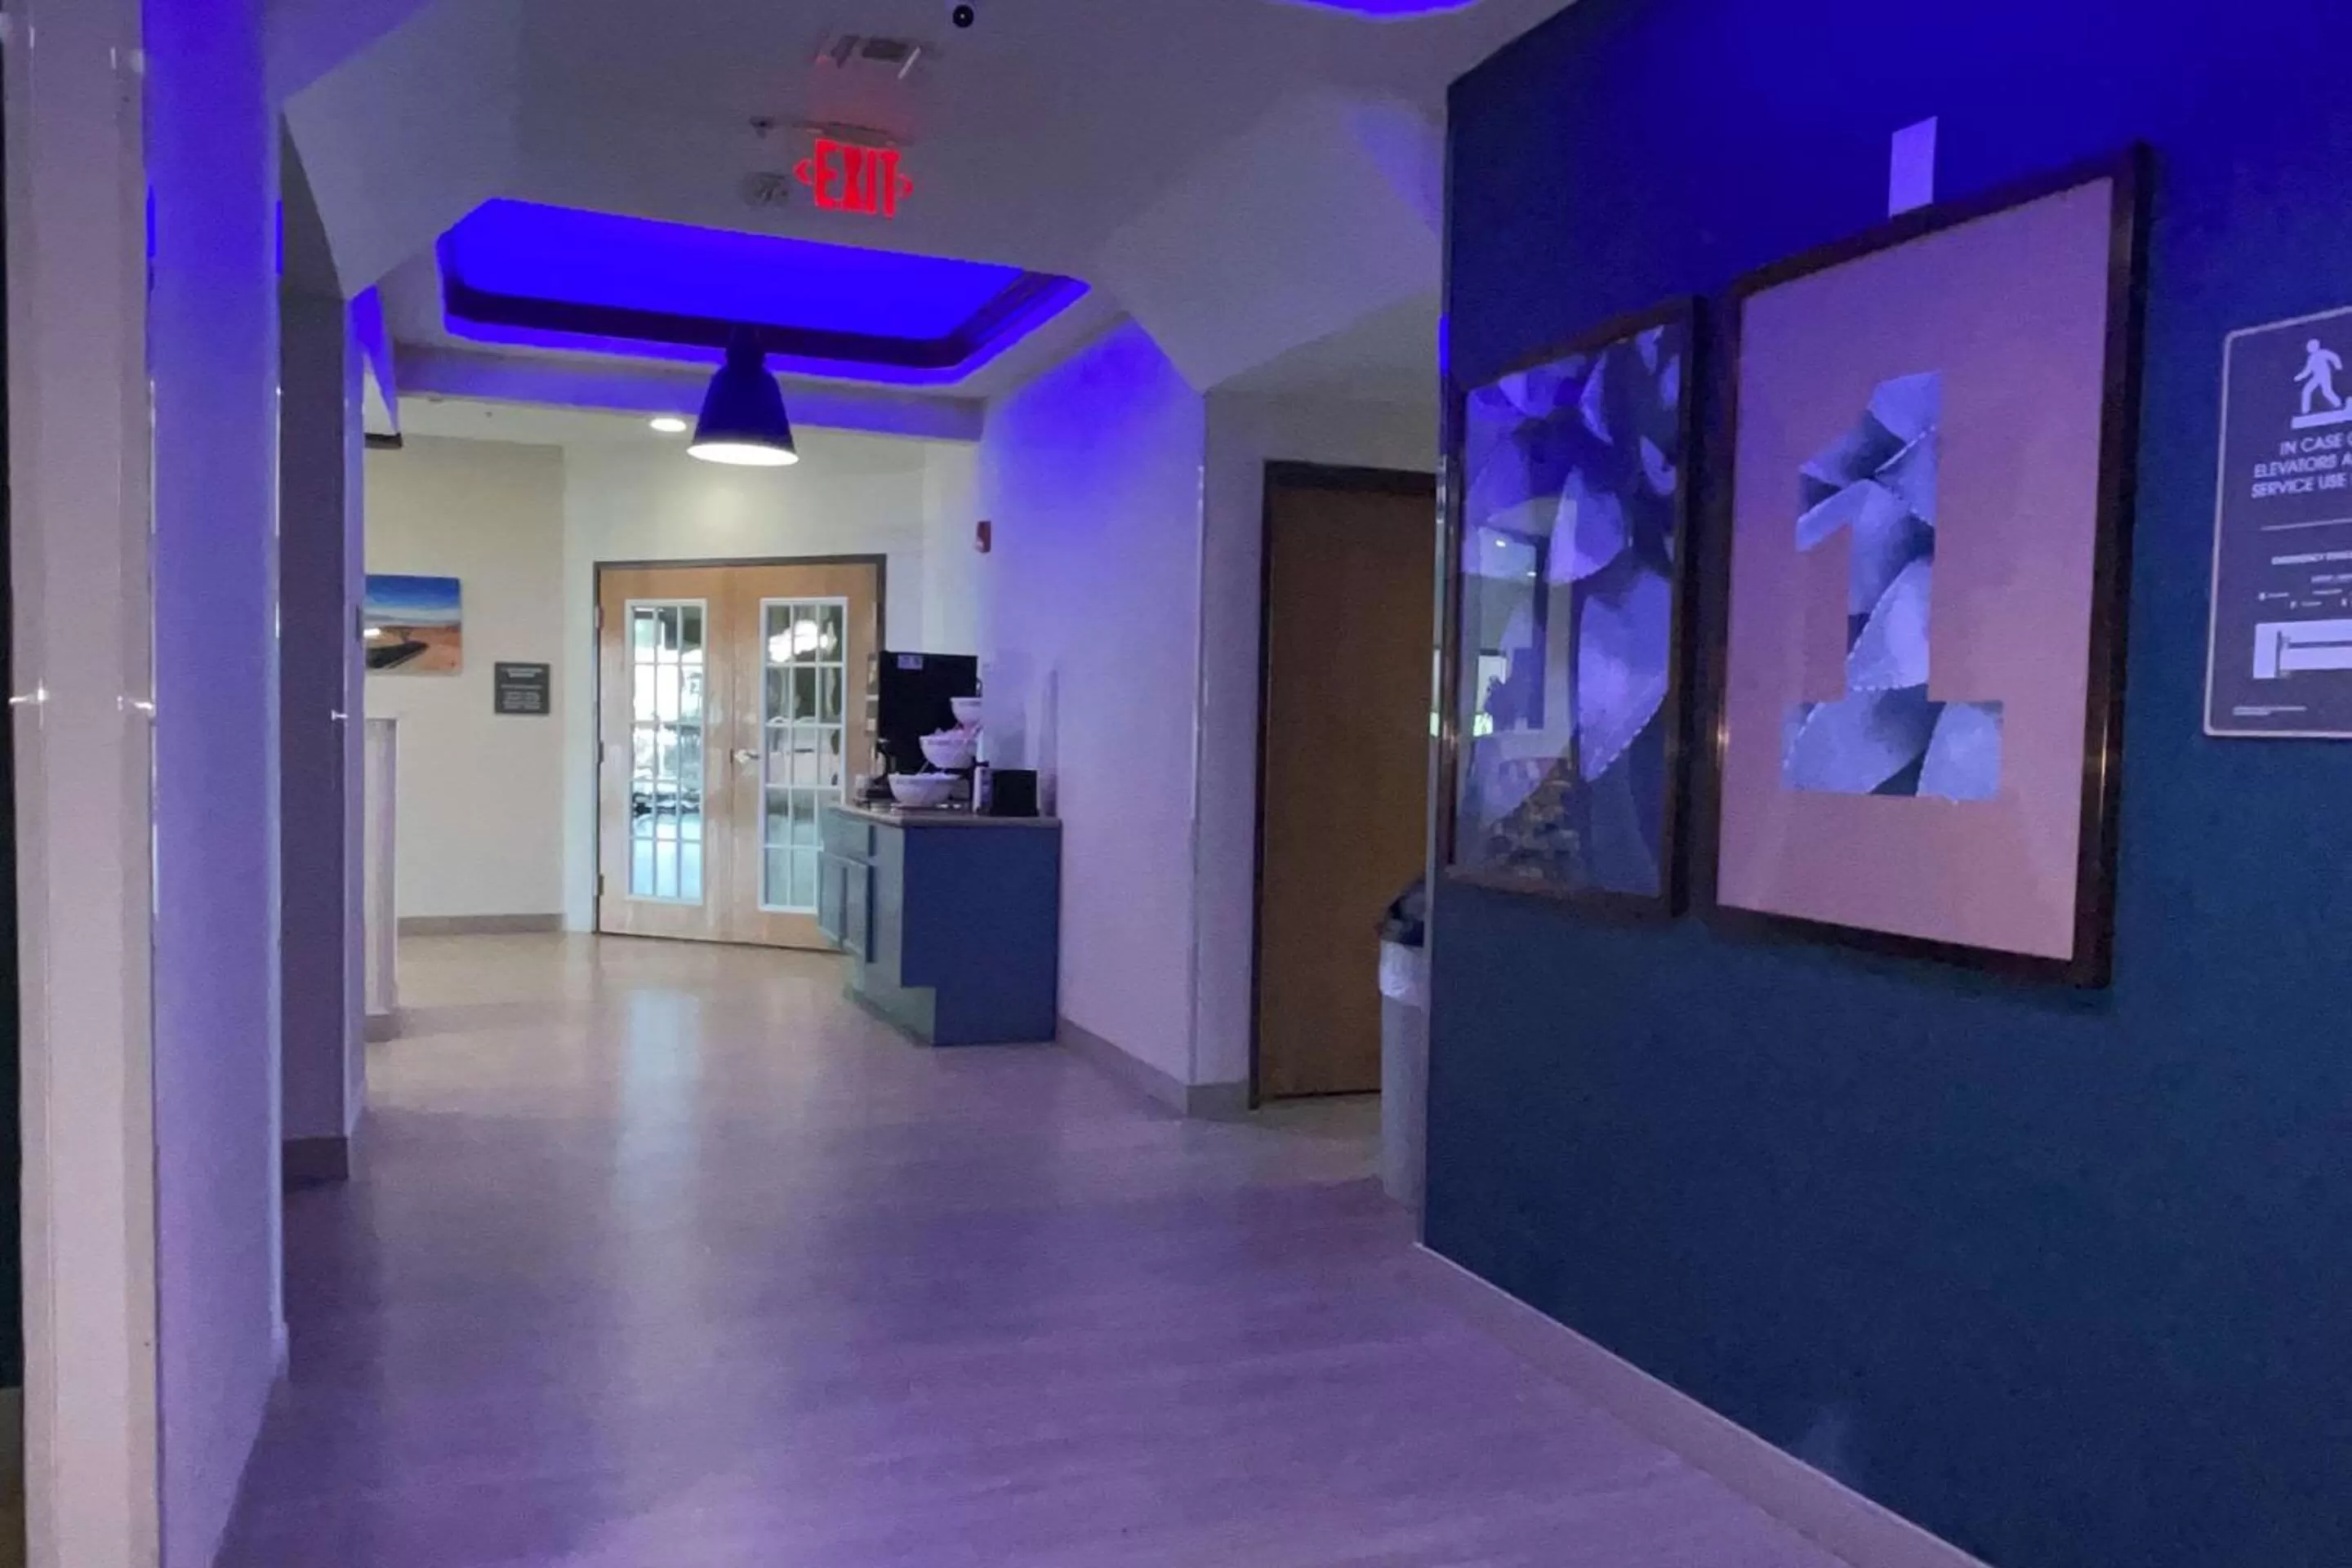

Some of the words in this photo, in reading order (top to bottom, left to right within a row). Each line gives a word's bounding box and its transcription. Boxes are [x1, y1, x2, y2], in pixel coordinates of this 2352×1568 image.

[814, 137, 902, 217] EXIT
[2279, 441, 2296, 456] IN
[2300, 432, 2343, 452] CASE
[2254, 453, 2336, 479] ELEVATORS
[2251, 476, 2314, 499] SERVICE
[2318, 472, 2346, 490] USE
[1781, 370, 2004, 801] 1
